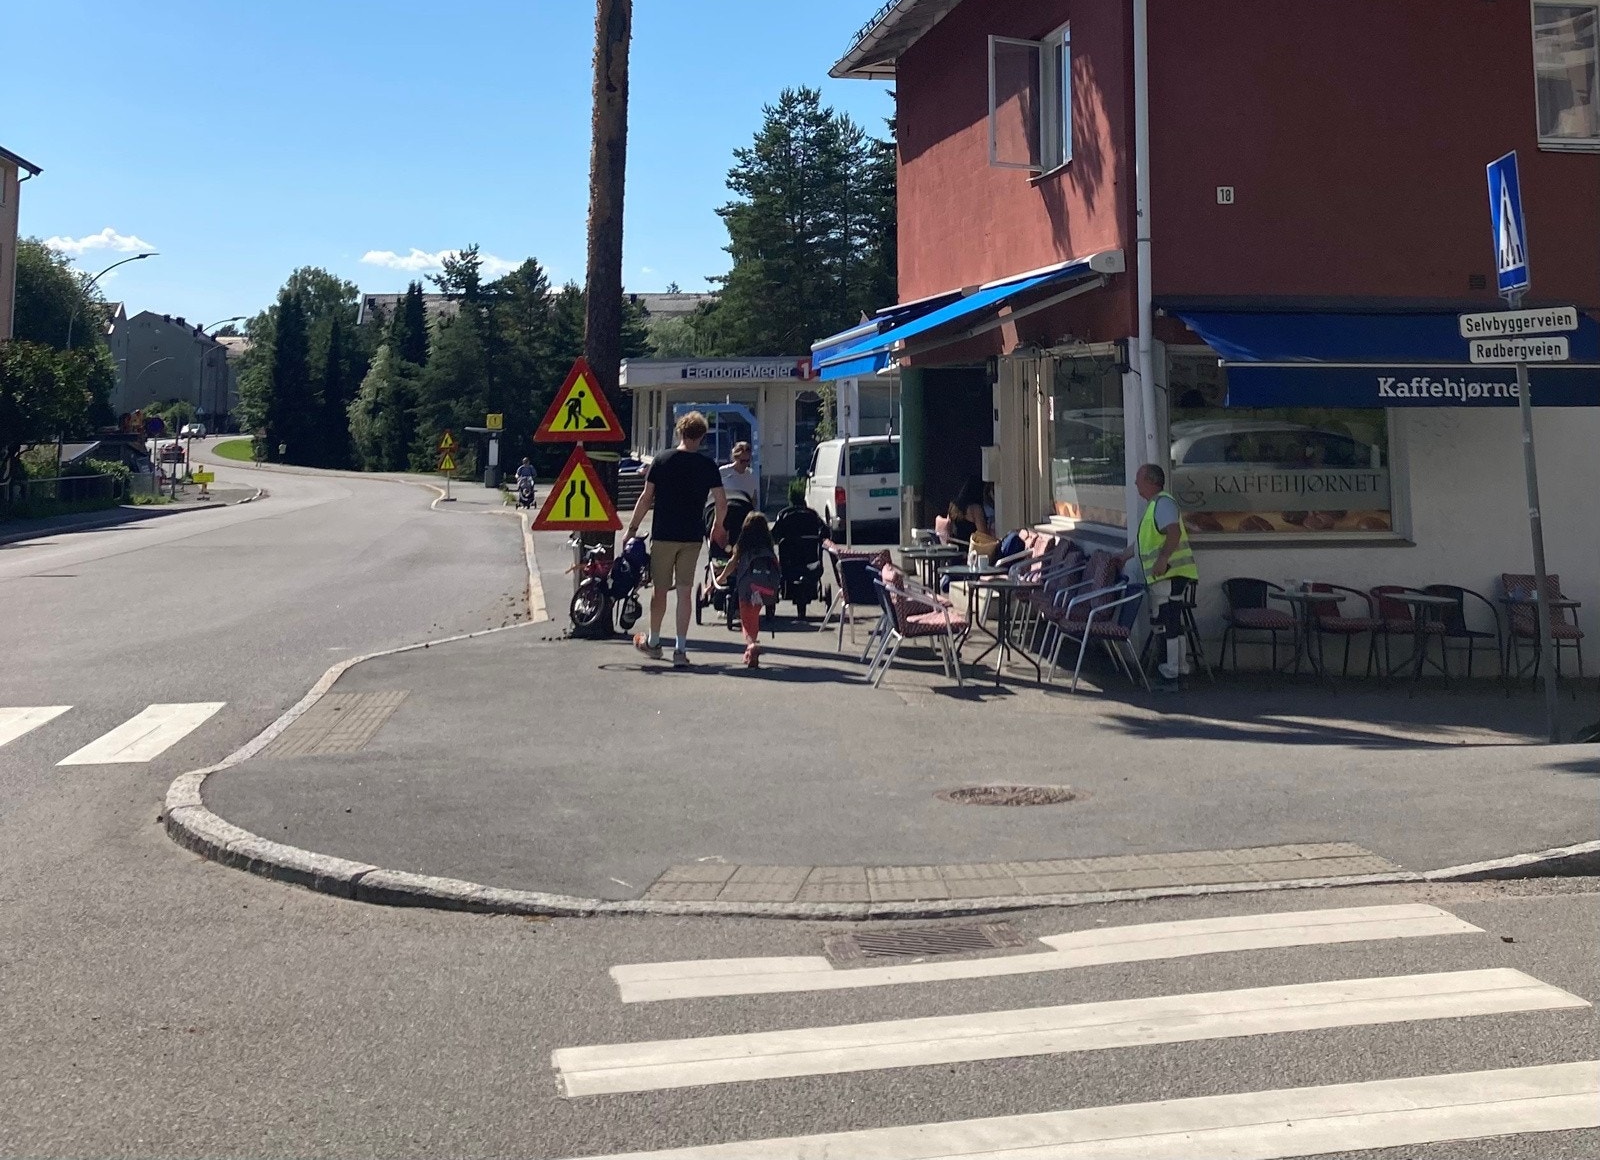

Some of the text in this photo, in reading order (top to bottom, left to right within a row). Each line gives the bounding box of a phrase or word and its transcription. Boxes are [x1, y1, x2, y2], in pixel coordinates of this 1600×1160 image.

[1219, 188, 1231, 202] 18
[1466, 311, 1572, 333] Selvbyggerveien
[1477, 341, 1562, 360] Rødbergveien
[686, 362, 810, 379] EiendomsMegler 1
[1214, 473, 1381, 497] KAFFEHJØRNET
